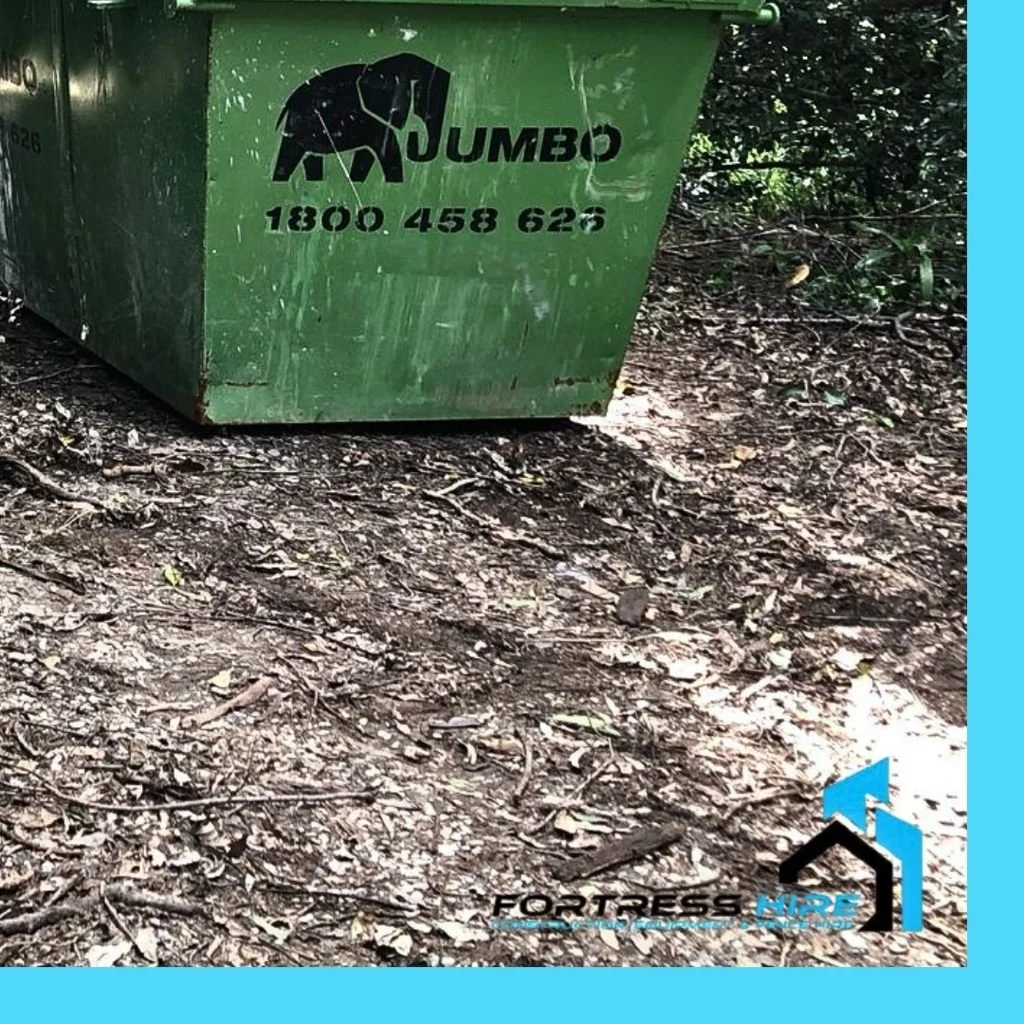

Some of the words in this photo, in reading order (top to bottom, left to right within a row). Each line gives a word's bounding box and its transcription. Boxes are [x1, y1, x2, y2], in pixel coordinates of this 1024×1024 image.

[407, 126, 622, 163] JUMBO
[265, 206, 384, 233] 1800
[404, 207, 498, 233] 458
[517, 207, 607, 233] 626
